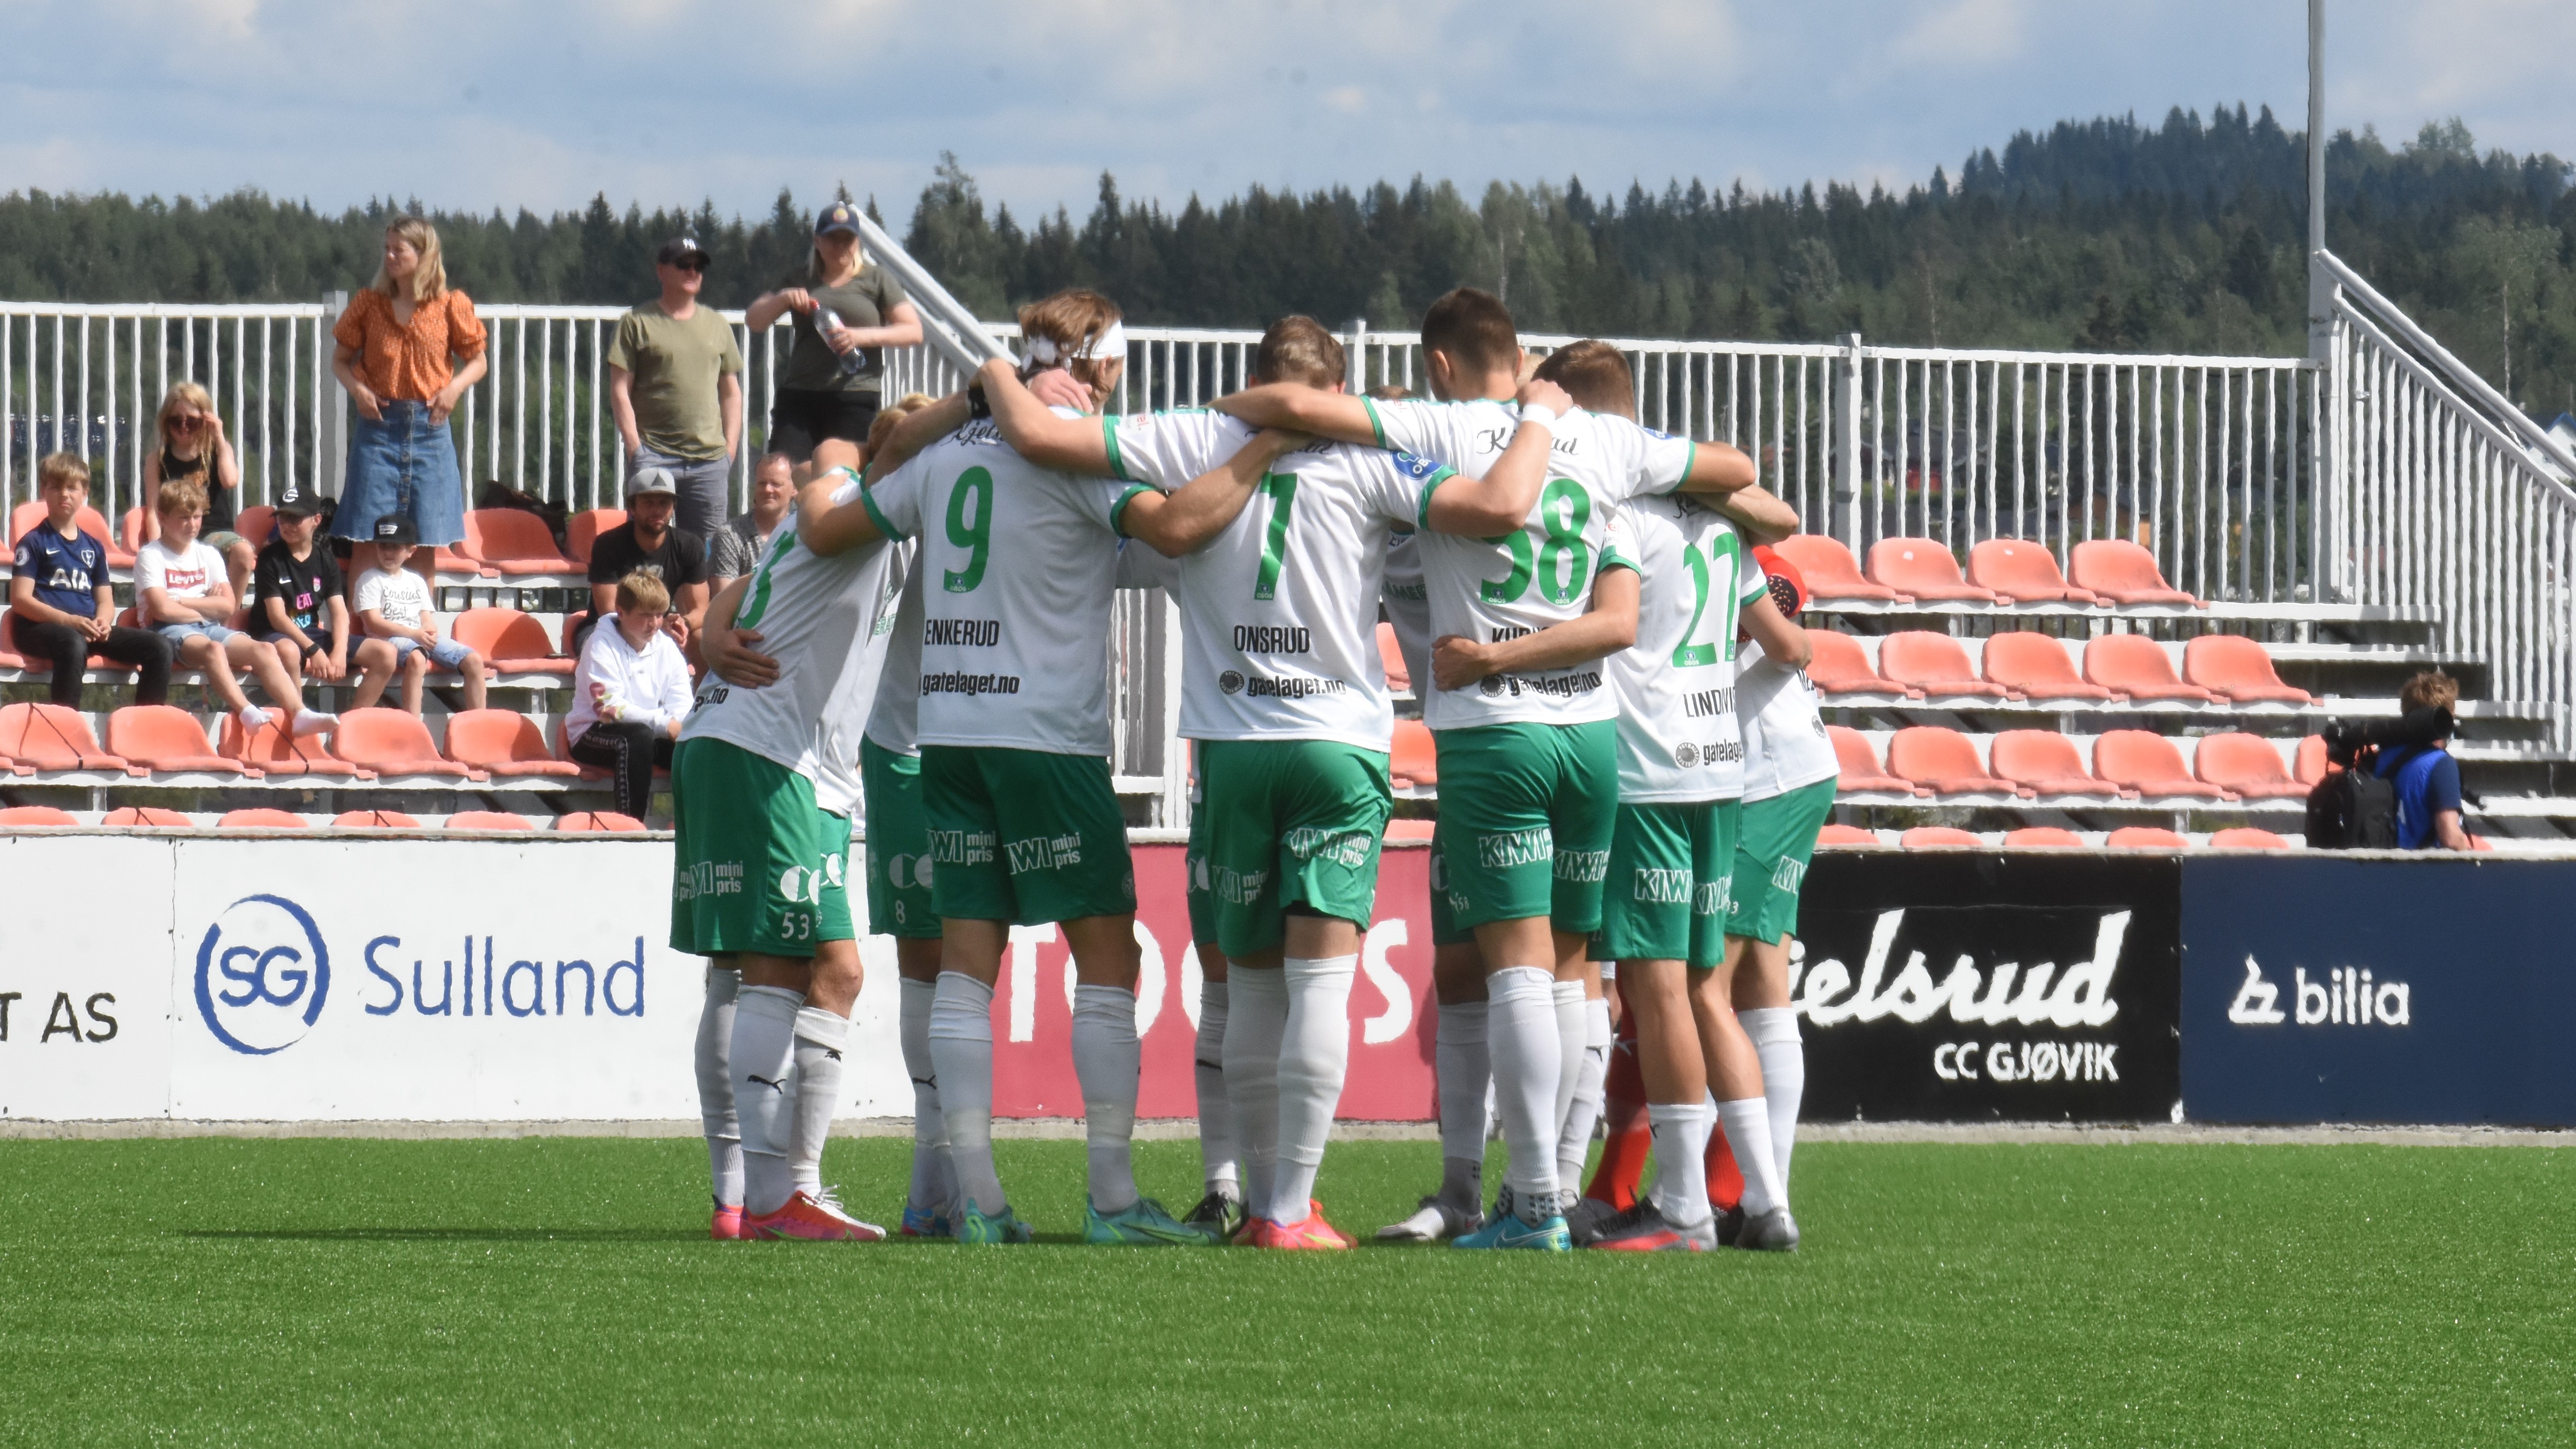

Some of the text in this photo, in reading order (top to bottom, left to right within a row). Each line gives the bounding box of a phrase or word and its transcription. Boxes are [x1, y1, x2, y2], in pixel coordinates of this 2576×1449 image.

[943, 465, 994, 594] 9
[1253, 471, 1298, 601] 7
[49, 568, 92, 590] AIA
[924, 619, 1000, 647] ENKERUD
[1234, 625, 1310, 654] ONSRUD
[922, 670, 1020, 696] gatelaget.no
[1683, 686, 1736, 718] LINDVI
[967, 831, 996, 847] mini
[1052, 832, 1081, 851] mini
[1478, 828, 1546, 868] KIWI
[716, 861, 743, 877] mini
[967, 848, 994, 866] pris
[1054, 849, 1081, 870] pris
[1339, 849, 1363, 866] pris
[717, 878, 741, 897] pris
[782, 911, 810, 940] 53
[895, 899, 906, 924] 8
[218, 946, 308, 1007] SG
[364, 935, 645, 1017] Sulland
[2296, 965, 2410, 1025] bilia
[40, 991, 119, 1043] AS
[1934, 1040, 2119, 1082] CC GJØVIK
